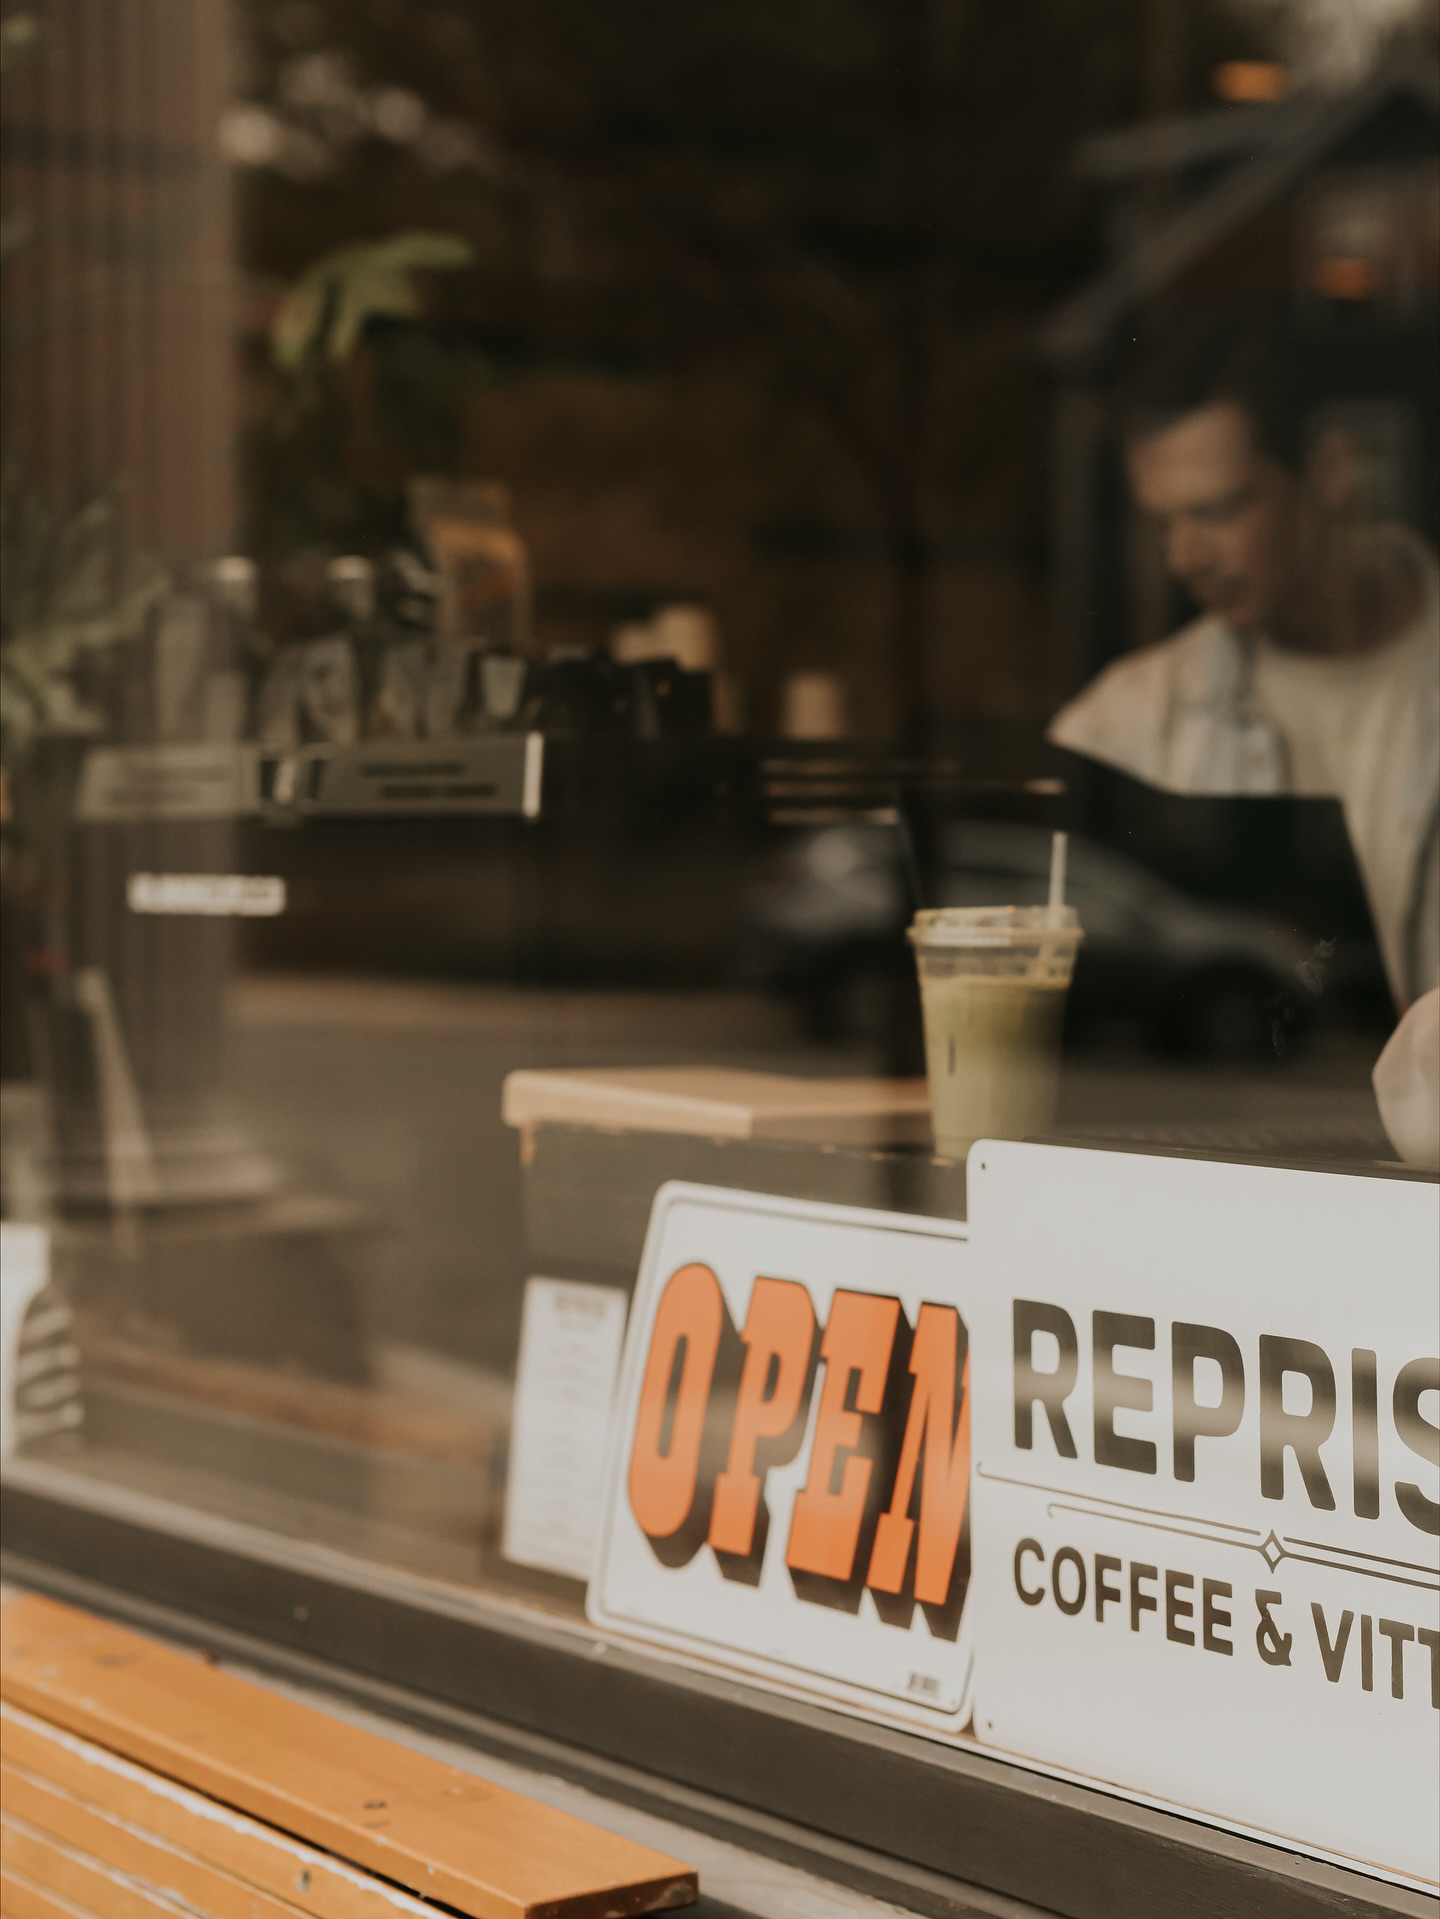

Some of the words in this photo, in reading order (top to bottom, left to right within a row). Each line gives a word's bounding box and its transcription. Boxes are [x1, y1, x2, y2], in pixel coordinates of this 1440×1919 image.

[627, 1262, 971, 1643] OPEN
[1013, 1298, 1440, 1536] REPRIS
[1013, 1537, 1234, 1657] COFFEE
[1254, 1588, 1293, 1667] &
[1310, 1601, 1440, 1710] VITT
